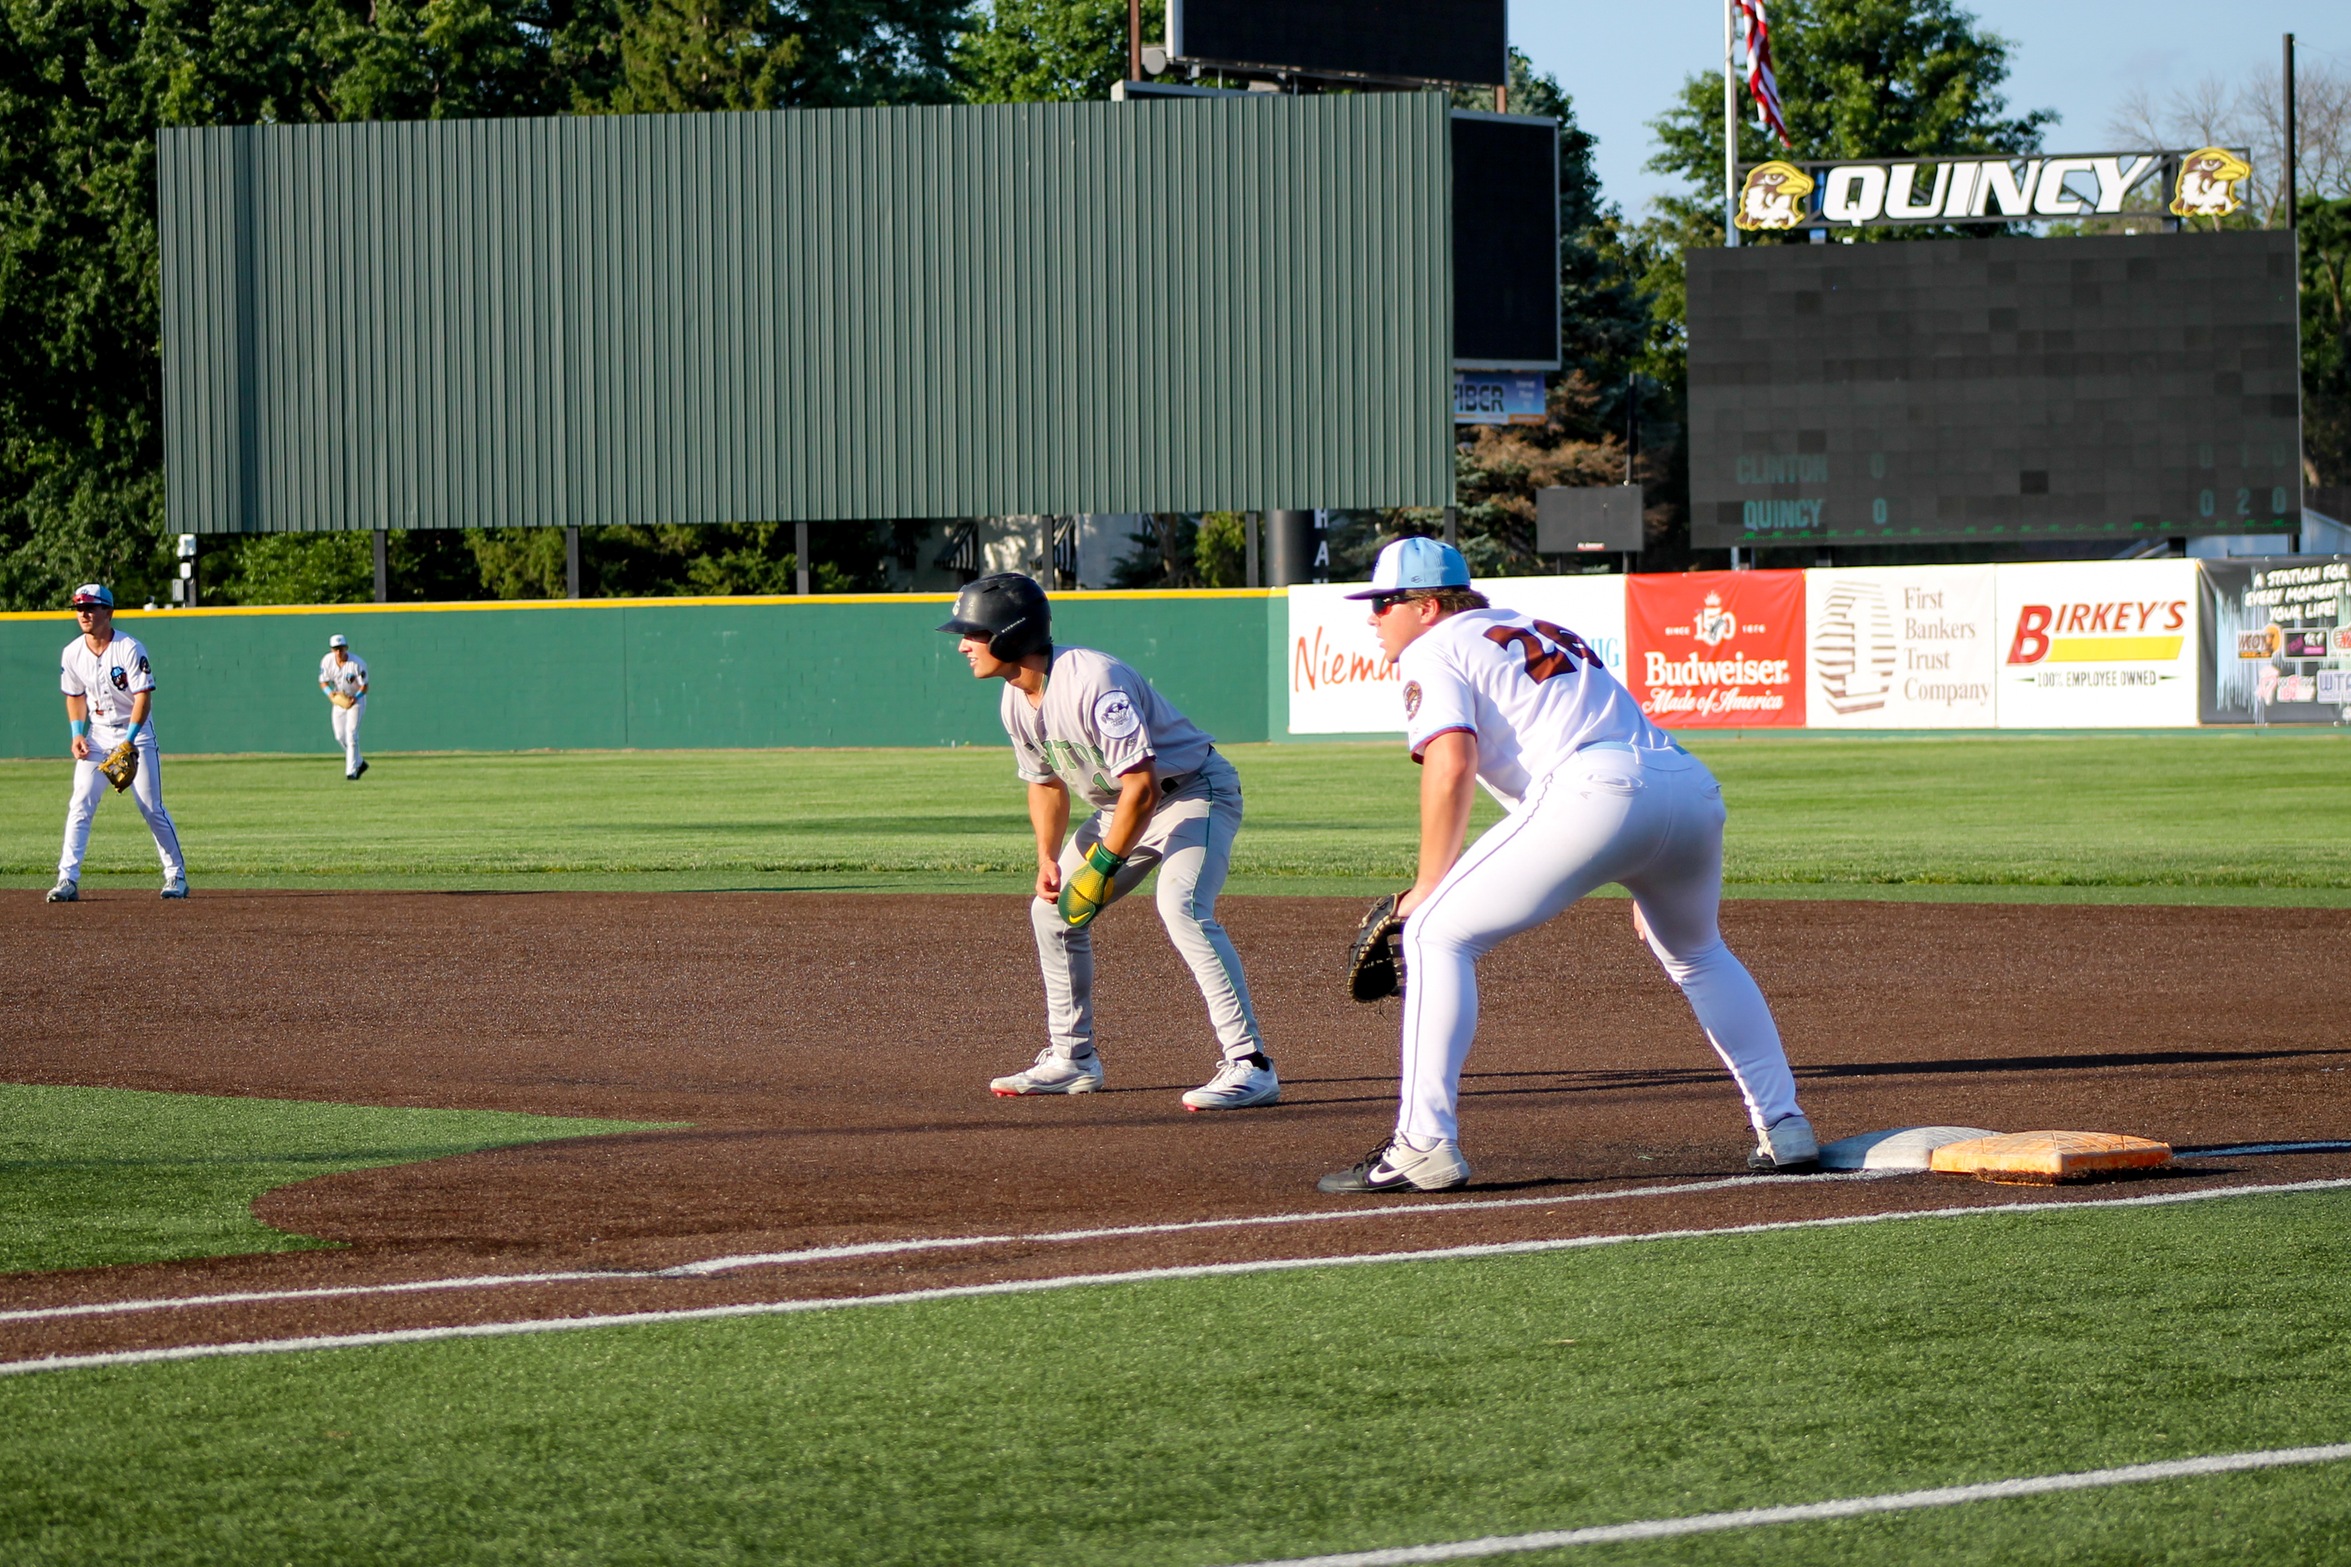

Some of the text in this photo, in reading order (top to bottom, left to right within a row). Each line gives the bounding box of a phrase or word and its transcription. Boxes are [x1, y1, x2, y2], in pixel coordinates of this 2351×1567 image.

[1822, 155, 2153, 227] QUINCY
[1743, 486, 2286, 531] QUINCY 0 0 2 0
[2253, 563, 2349, 588] A STATION FOR
[1904, 587, 1943, 609] First
[2245, 588, 2285, 607] EVERY
[2285, 581, 2344, 603] MOMENT
[2269, 598, 2337, 622] YOUR LIFE!
[1905, 617, 1976, 639] Bankers
[2006, 601, 2187, 666] BIRKEY'S
[1295, 626, 1400, 692] Niema
[1644, 651, 1788, 686] Budweiser
[1904, 648, 1950, 670] Trust
[1904, 677, 1990, 706] Company
[2038, 670, 2156, 687] 100% EMPLOYEE OWNED
[1642, 687, 1784, 717] Made of America
